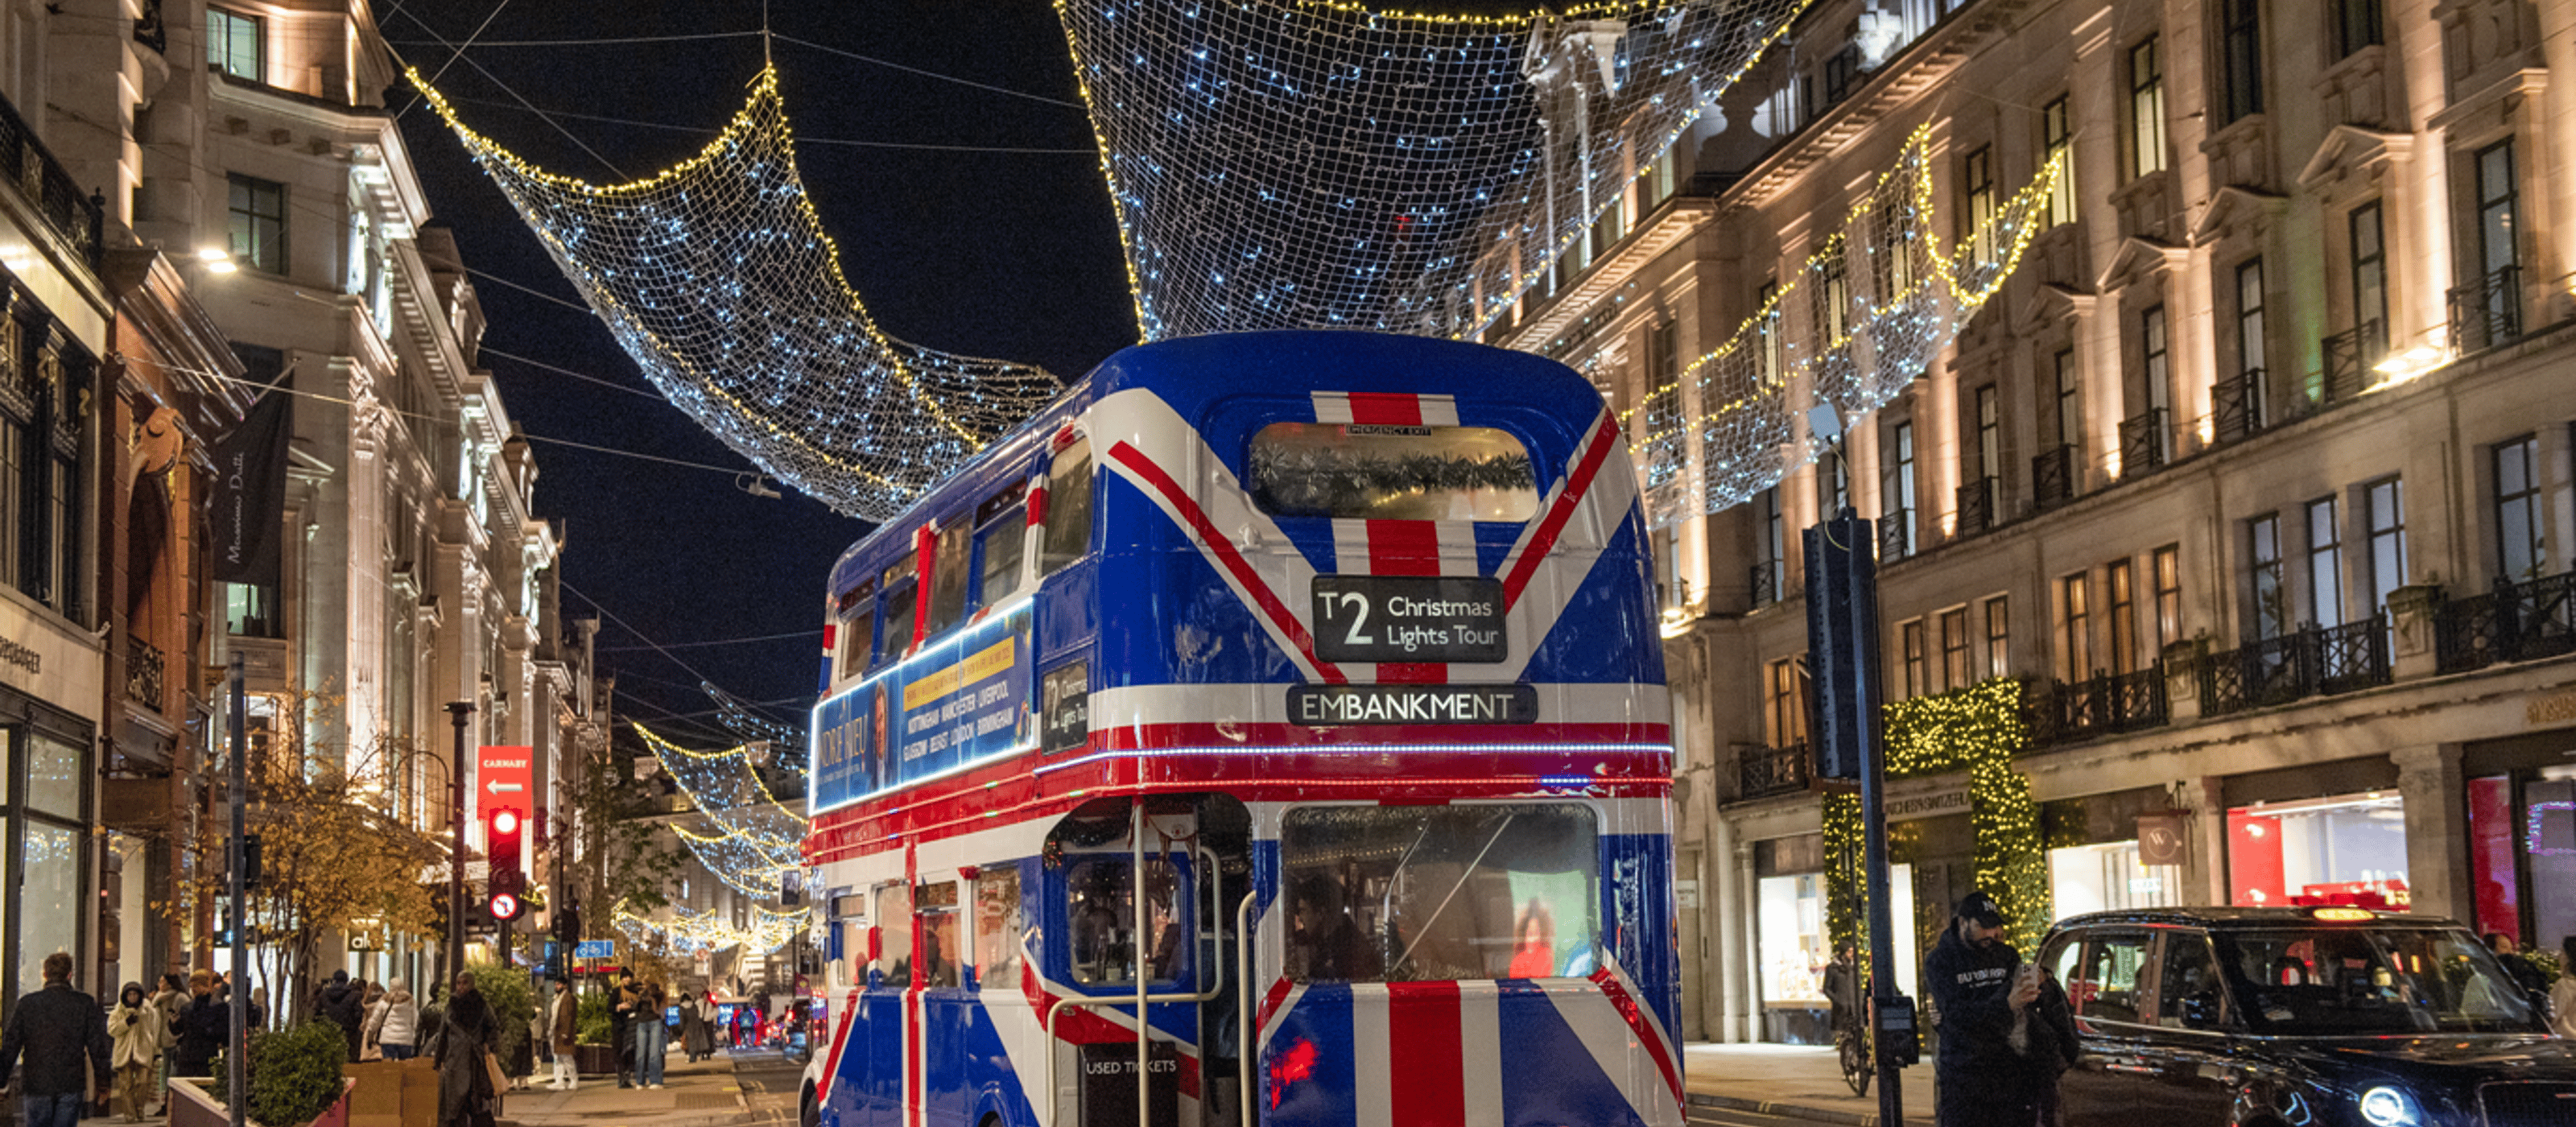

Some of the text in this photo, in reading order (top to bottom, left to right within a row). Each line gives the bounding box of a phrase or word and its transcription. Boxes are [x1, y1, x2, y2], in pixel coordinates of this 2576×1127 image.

[227, 451, 244, 564] Massimo Dutti
[1318, 592, 1373, 644] T2
[1388, 597, 1492, 617] Christmas
[1387, 625, 1498, 652] Lights Tour
[907, 679, 1009, 735] NOTTINGHAM MANCHESTER LIVERPOOL
[1302, 694, 1514, 720] EMBANKMENT
[902, 706, 1014, 762] GLASGOW BELFAST LONDON BIRMINGHAM
[483, 759, 529, 768] CARNABY
[1086, 1059, 1176, 1075] USED TIKETS
